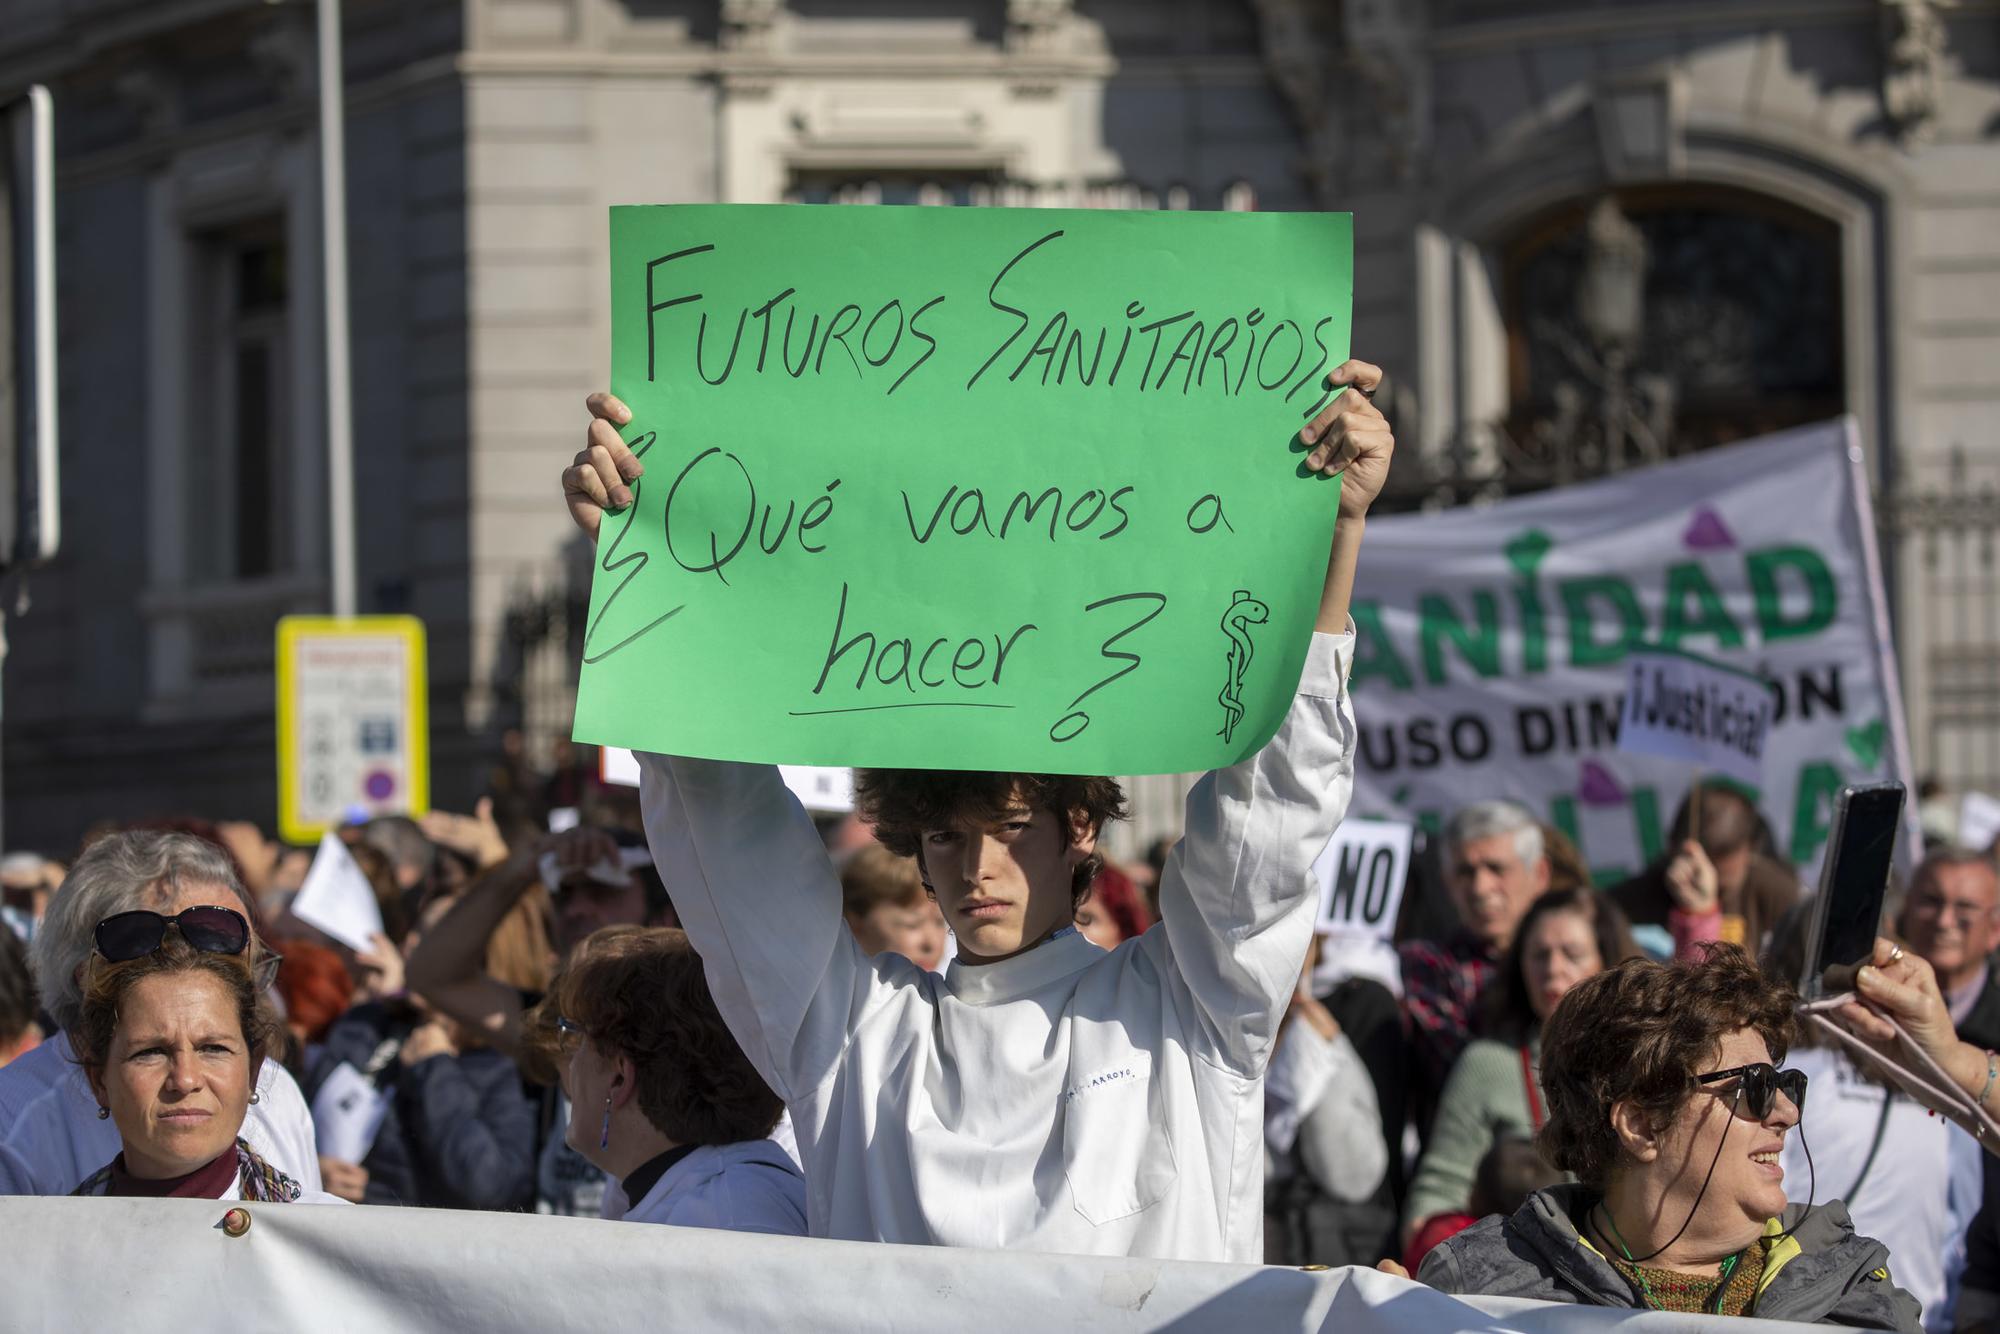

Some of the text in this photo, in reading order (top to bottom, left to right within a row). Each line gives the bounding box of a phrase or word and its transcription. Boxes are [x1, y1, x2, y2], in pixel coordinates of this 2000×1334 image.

[646, 243, 946, 395] FUTUROS
[901, 485, 1134, 544] vamos
[1186, 494, 1234, 534] a
[1348, 532, 1838, 692] ANIDAD
[1358, 712, 1490, 773] USO
[1328, 842, 1394, 925] NO
